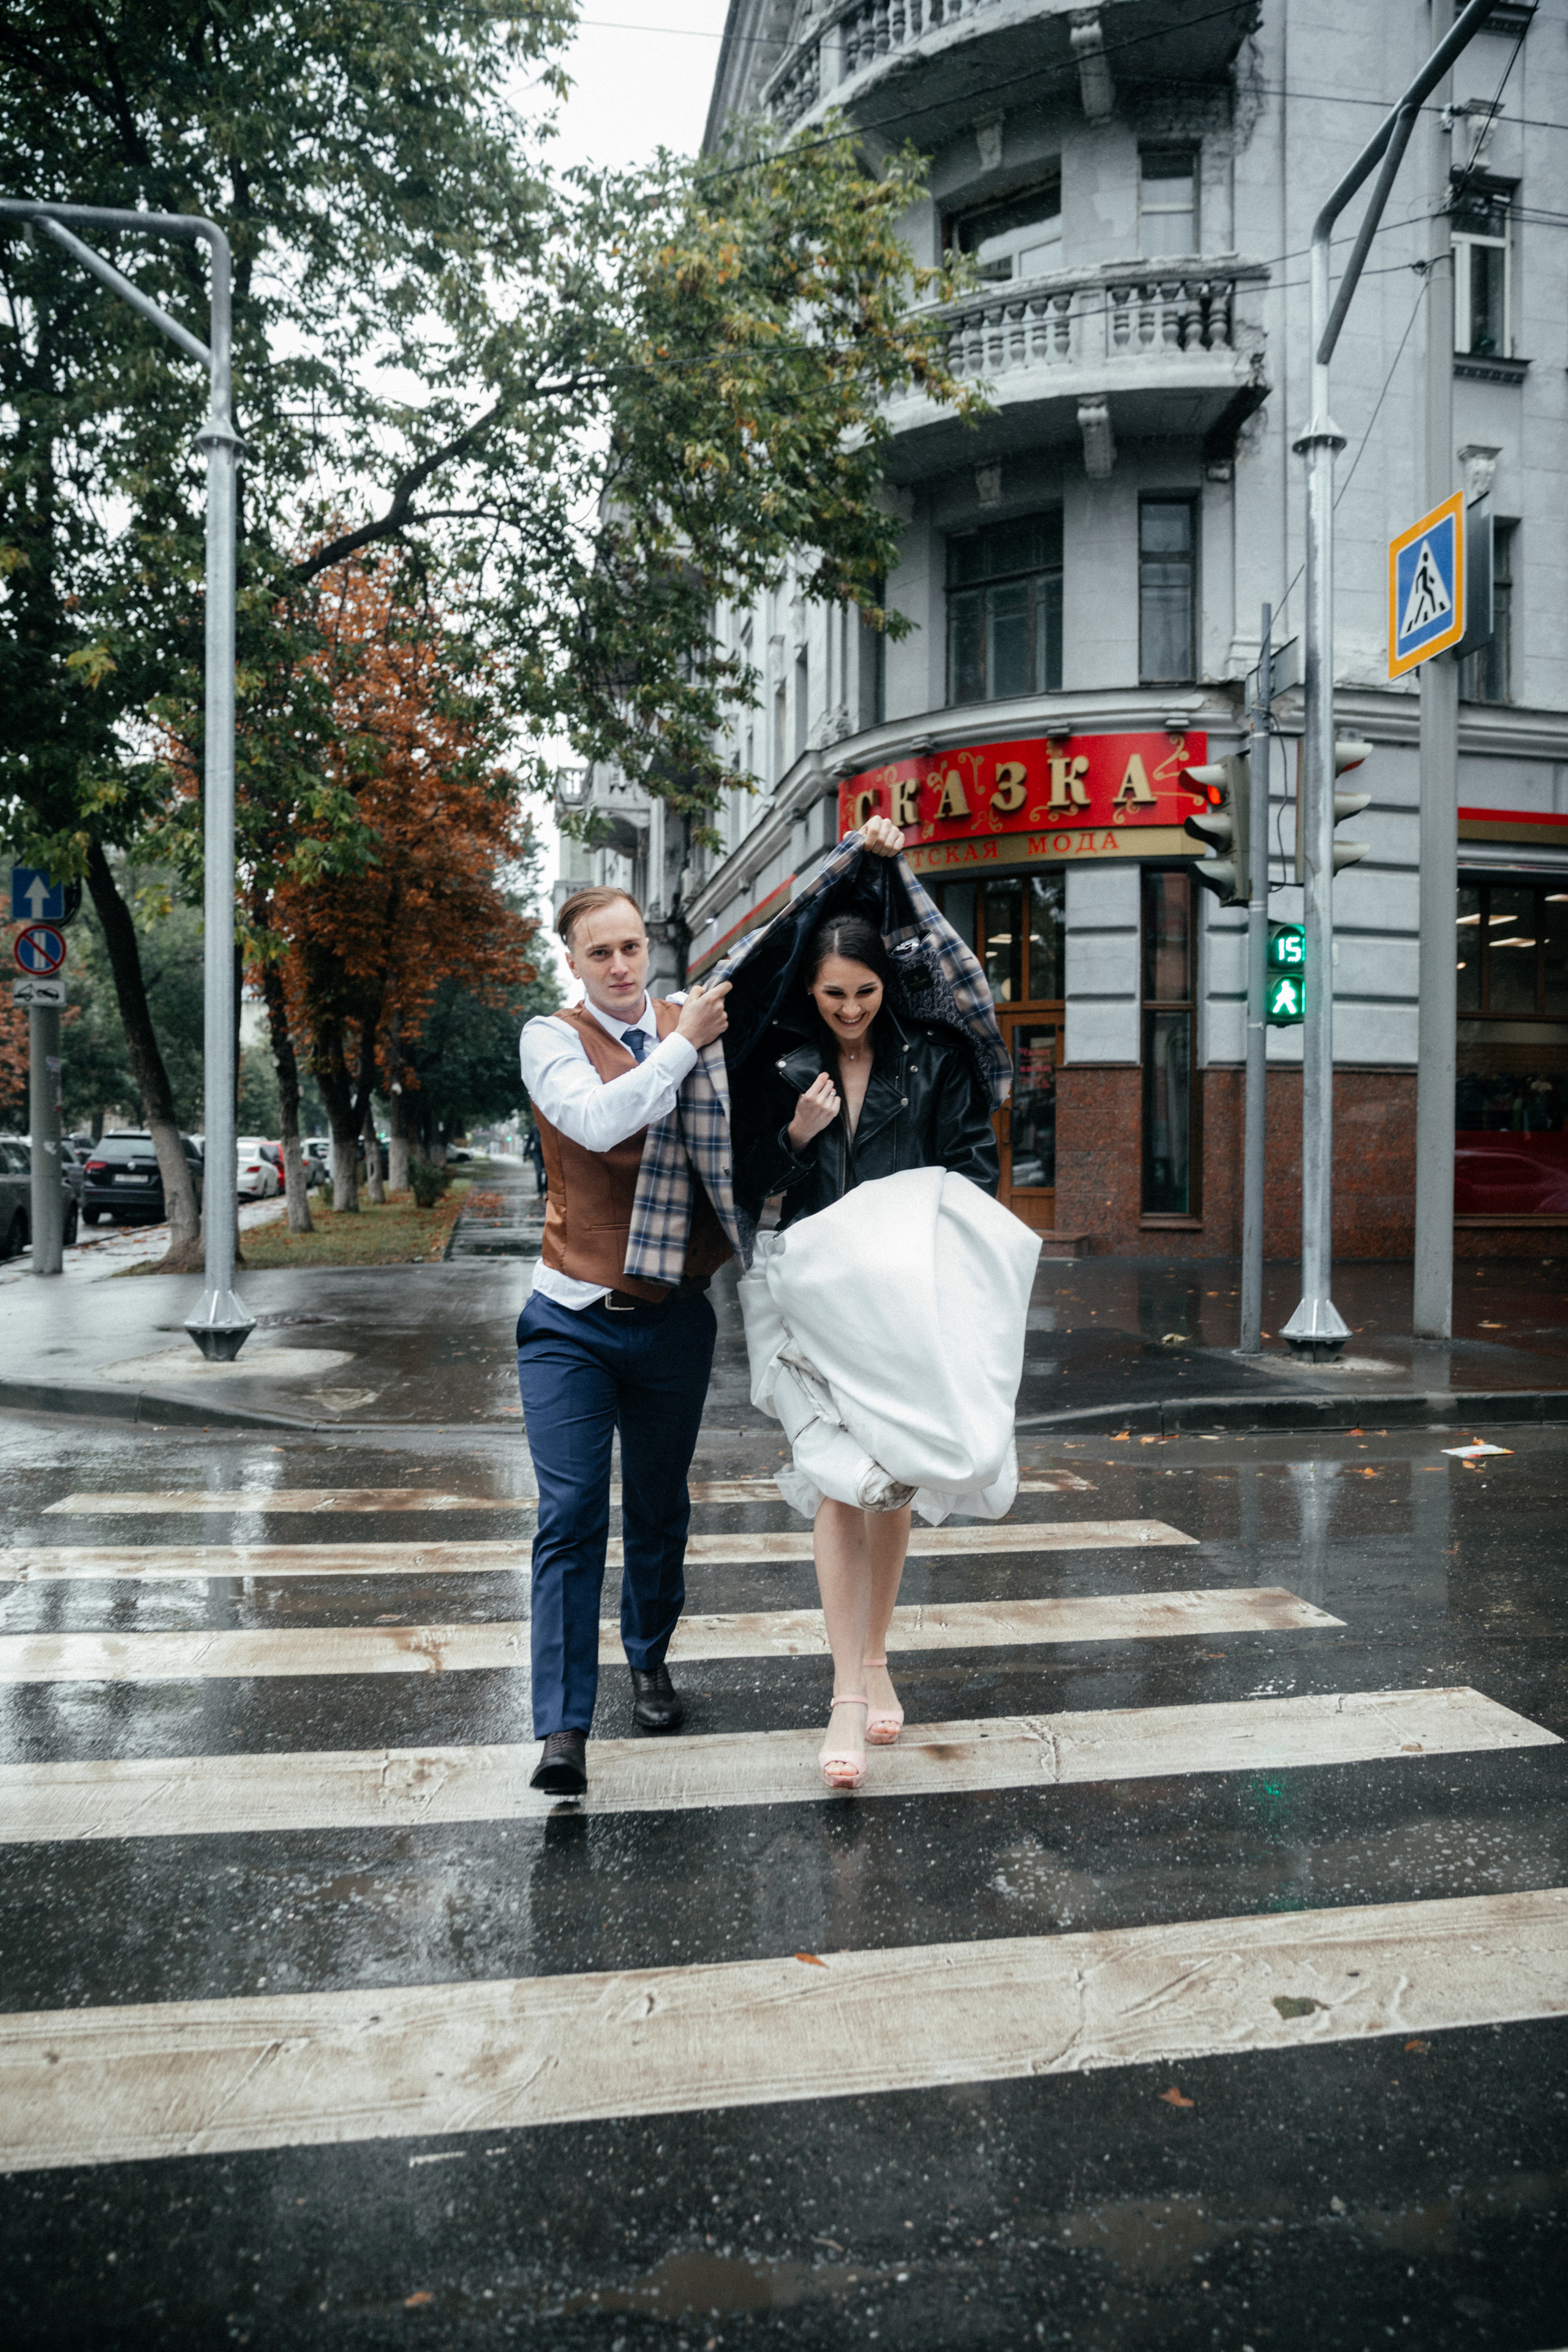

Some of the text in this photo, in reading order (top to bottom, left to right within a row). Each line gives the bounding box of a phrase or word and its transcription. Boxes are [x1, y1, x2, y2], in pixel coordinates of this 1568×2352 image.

[855, 753, 1157, 829] СКАЗКА
[903, 831, 1120, 868] ТСКАЯ МОДА
[1278, 937, 1302, 962] 15
